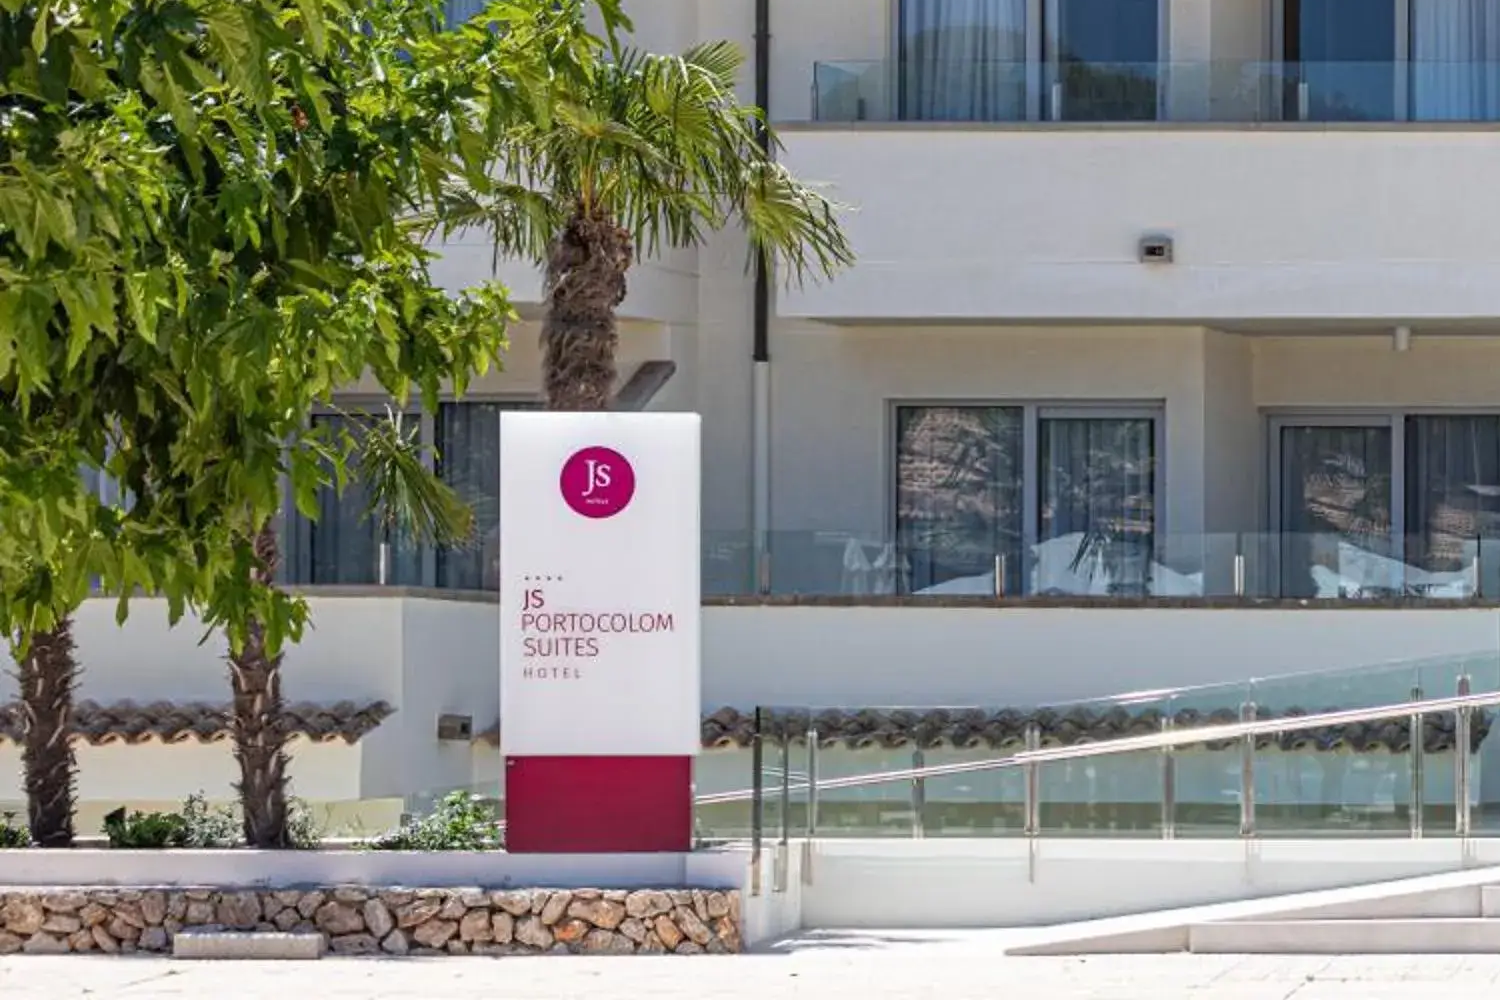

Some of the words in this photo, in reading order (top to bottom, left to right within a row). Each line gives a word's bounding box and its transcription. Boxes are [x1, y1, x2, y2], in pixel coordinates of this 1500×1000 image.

[523, 589, 545, 611] JS
[521, 613, 674, 633] PORTOCOLOM
[523, 637, 599, 657] SUITES
[523, 667, 581, 679] HOTEL
